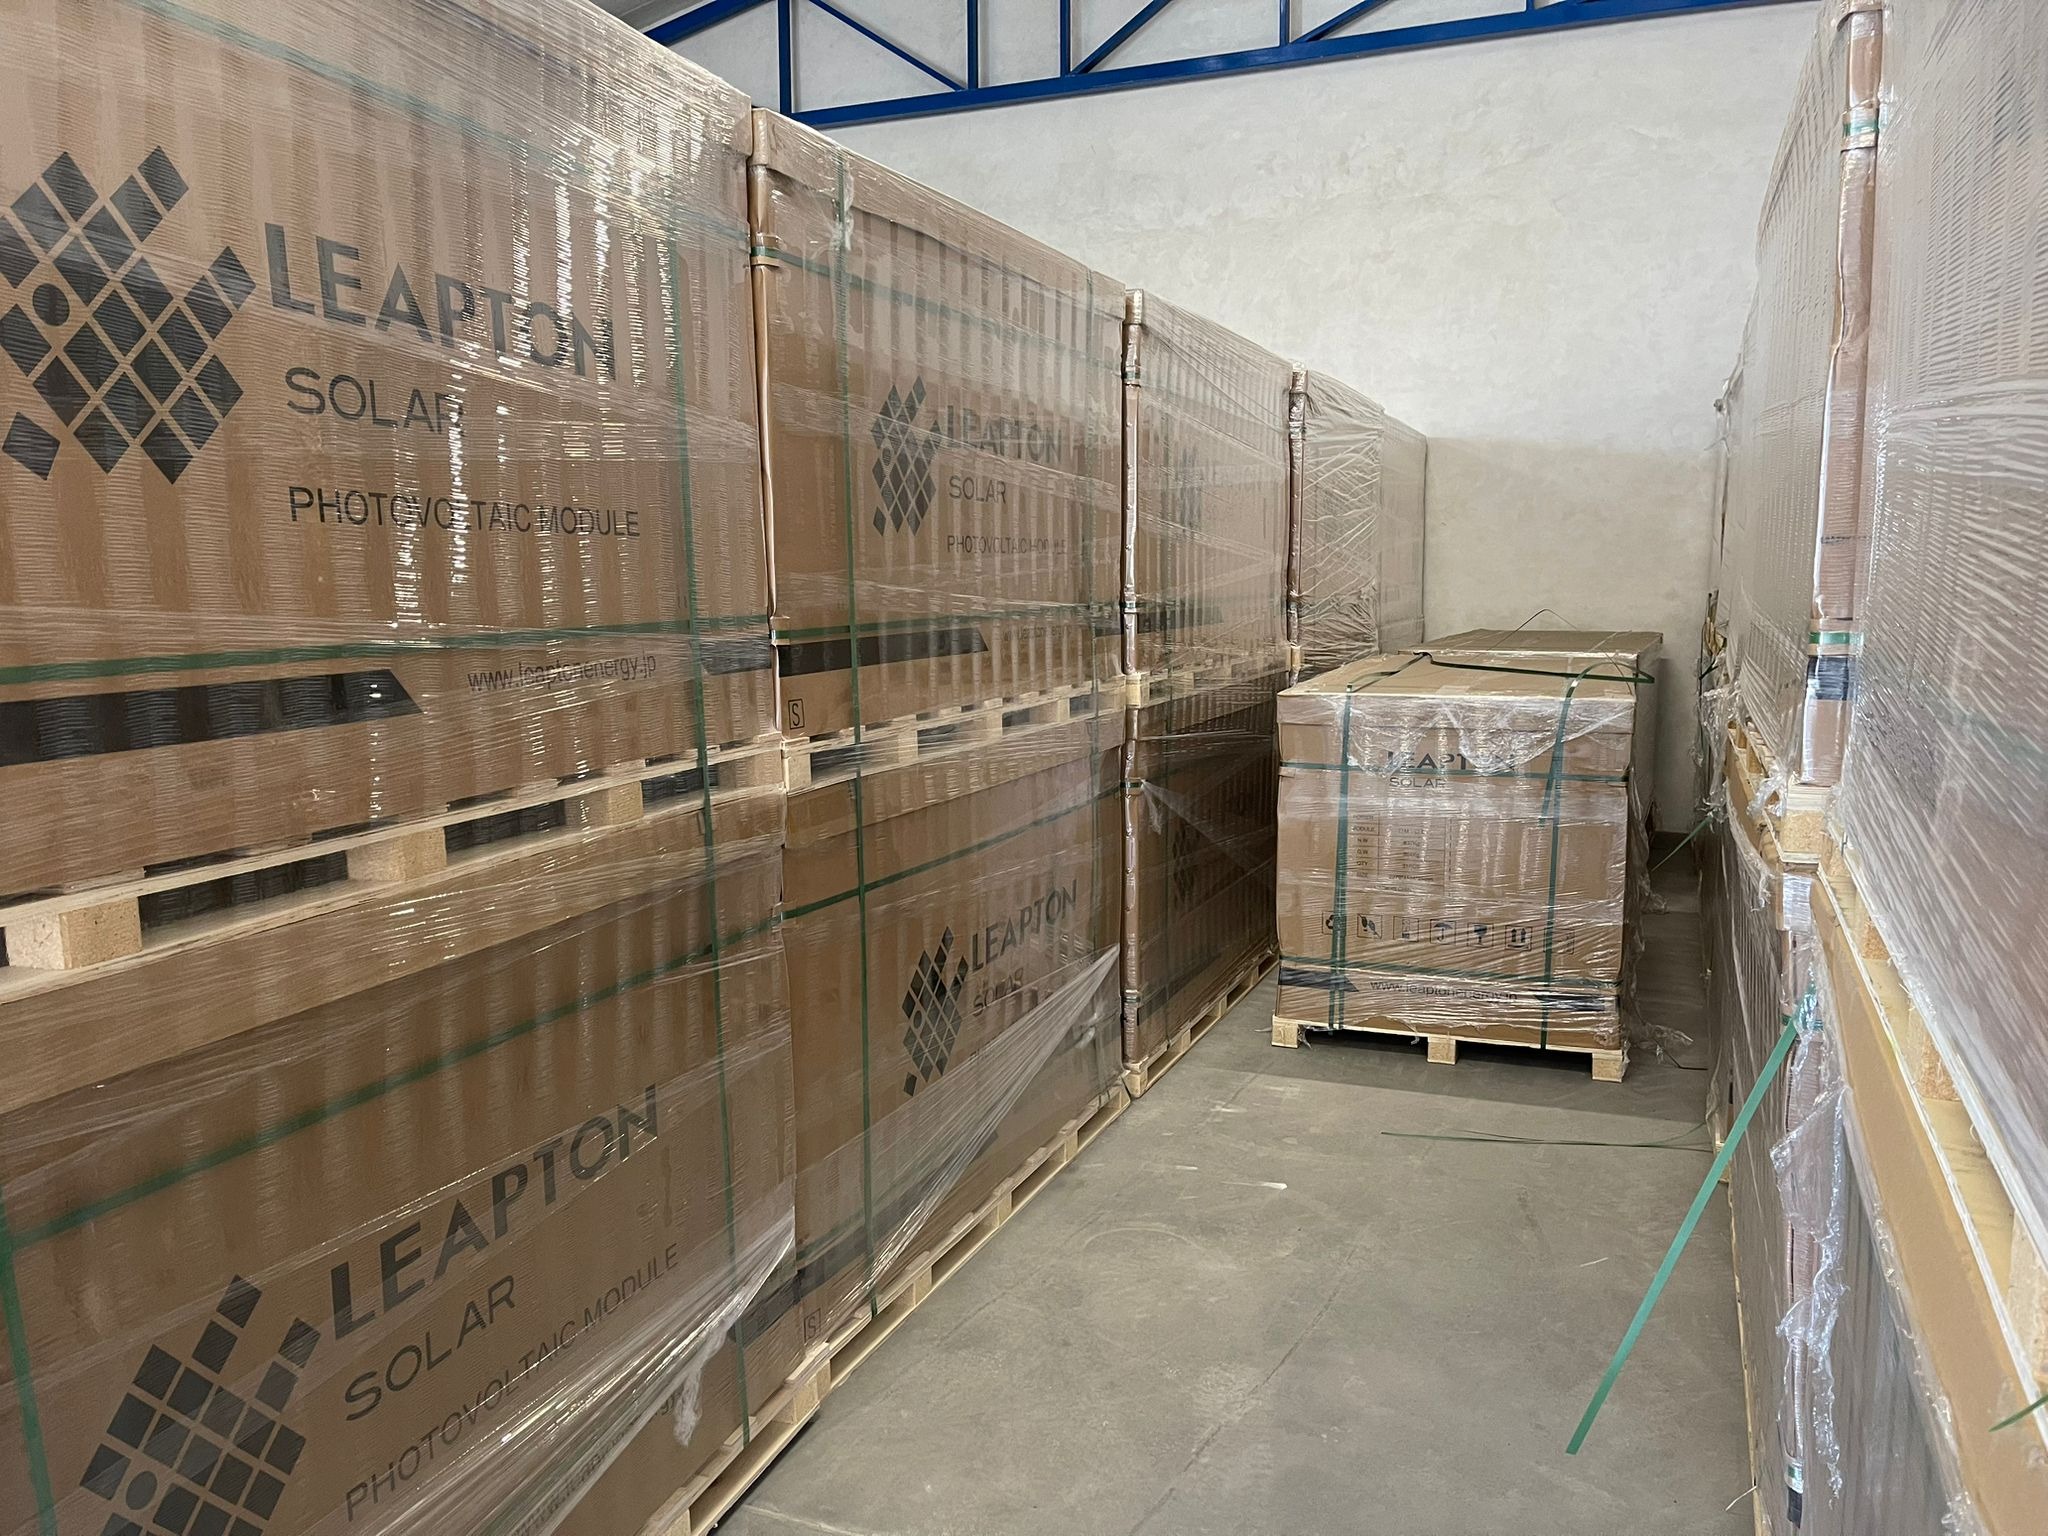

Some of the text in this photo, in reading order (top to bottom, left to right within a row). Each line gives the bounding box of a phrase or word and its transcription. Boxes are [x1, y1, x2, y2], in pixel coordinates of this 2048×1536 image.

[265, 222, 616, 381] LEAPTON
[539, 503, 641, 538] MODULE
[949, 474, 1007, 504] SOLAR
[972, 878, 1077, 974] LEAPTON
[331, 1083, 658, 1341] LEAPTON
[344, 1275, 515, 1421] SOLAR
[345, 1319, 577, 1522] PHOTOVOLTAIC
[584, 1243, 678, 1332] MODULE
